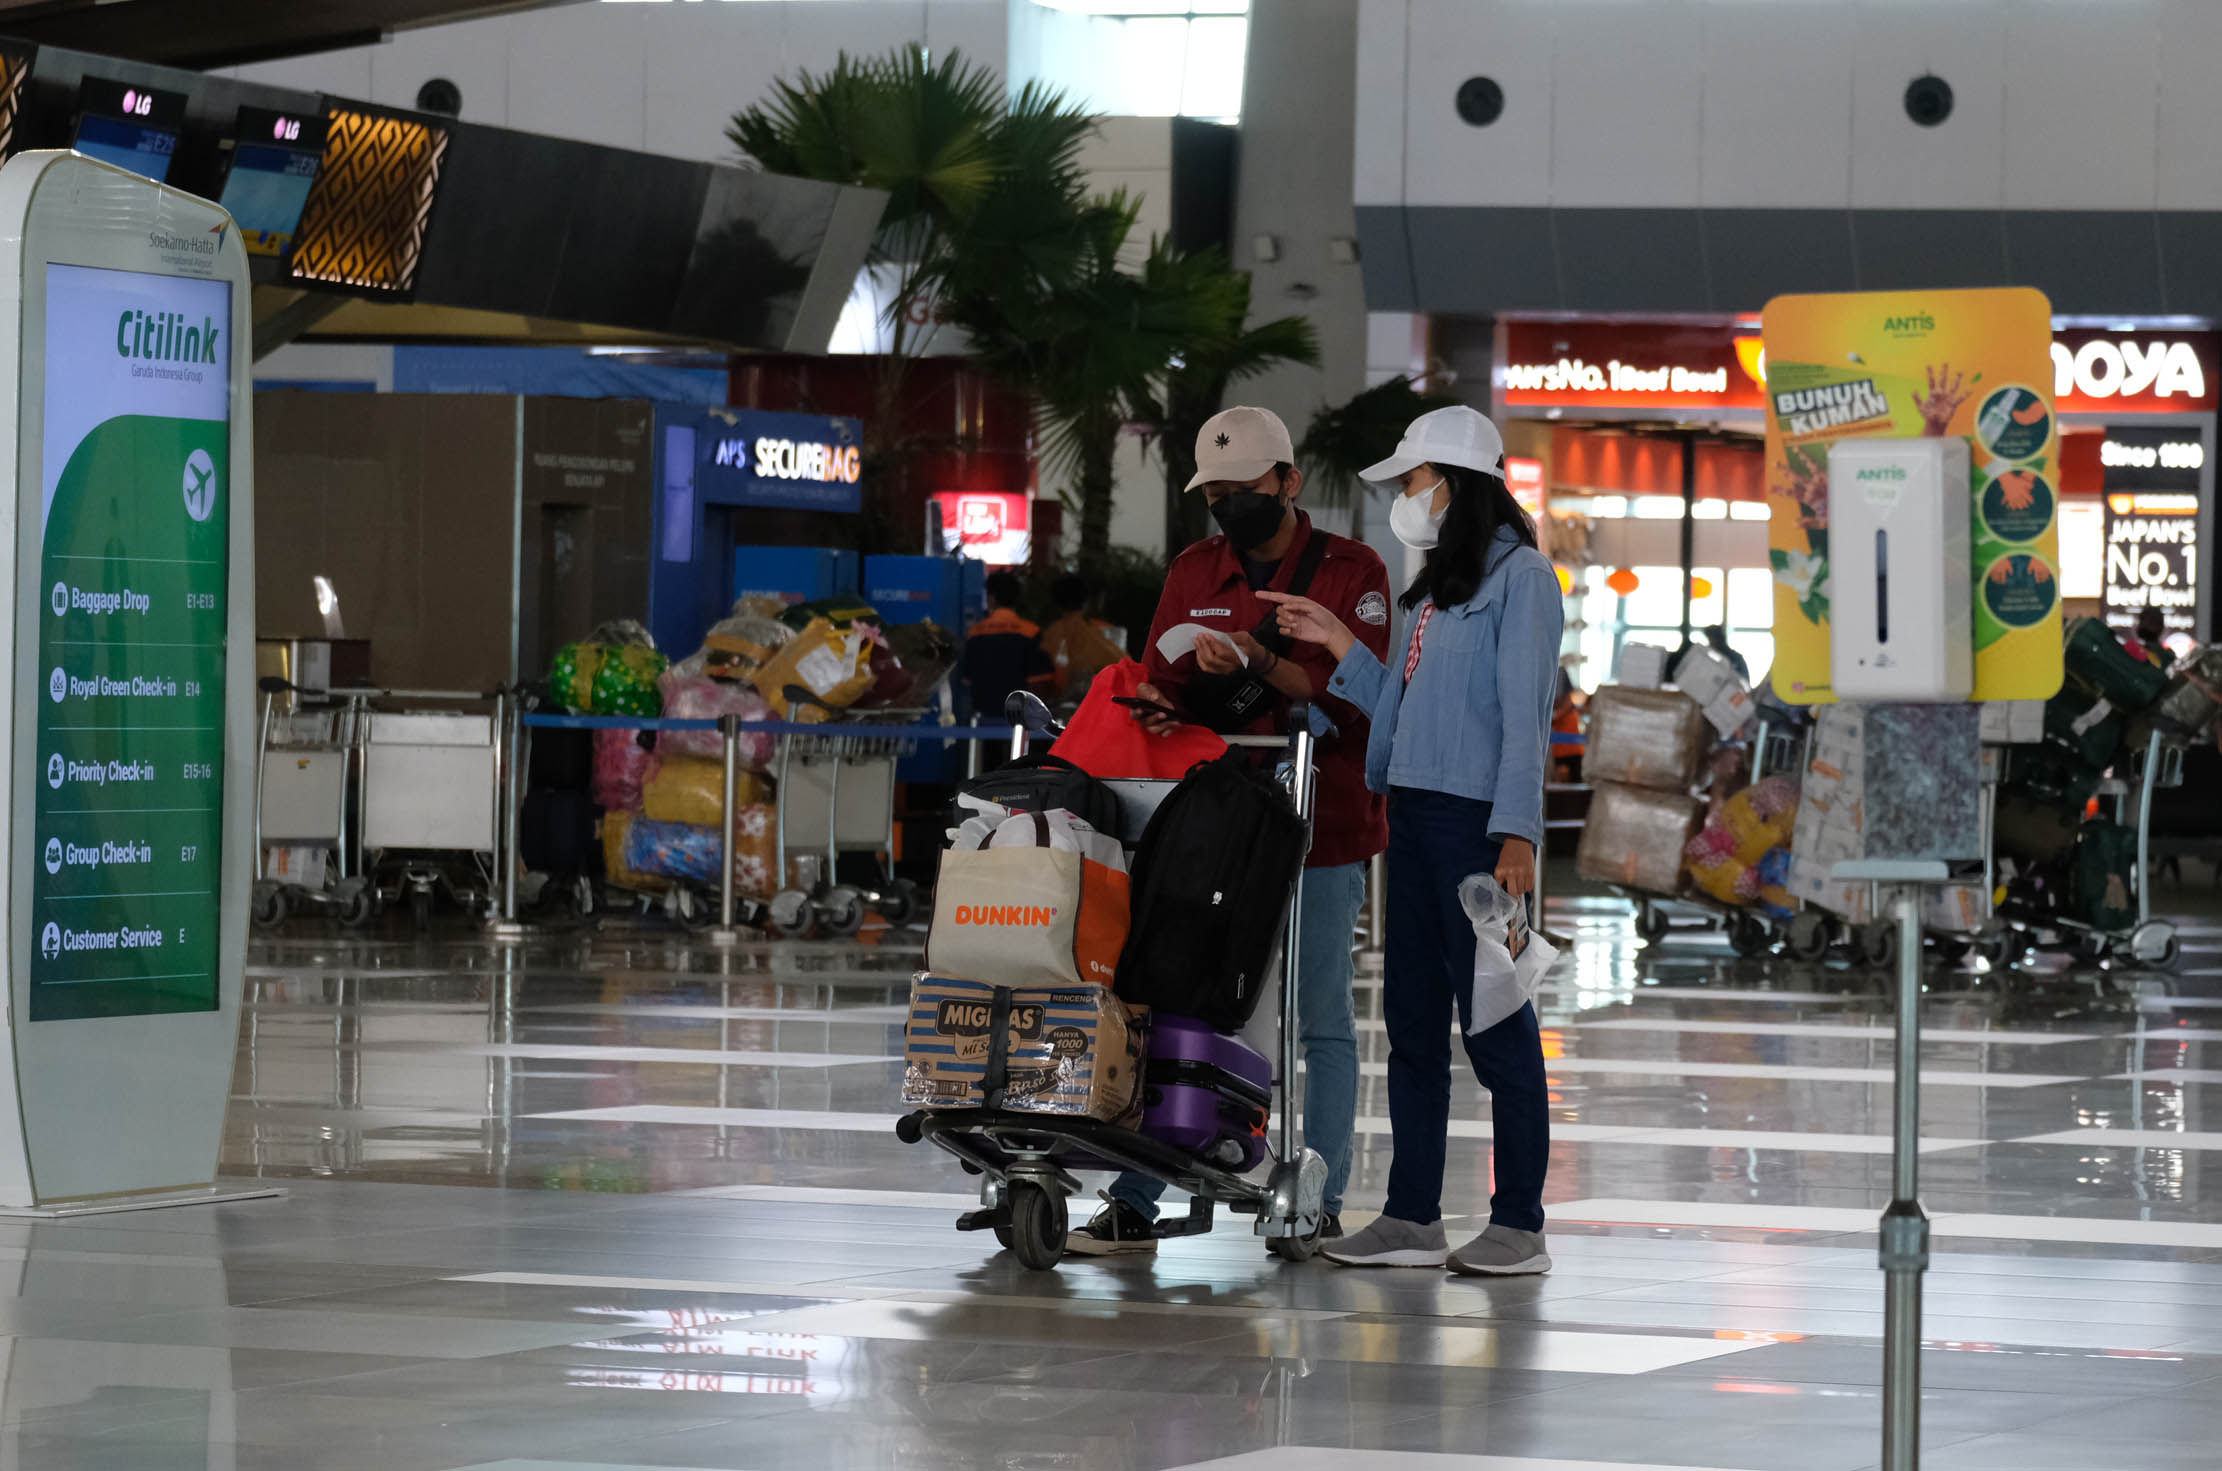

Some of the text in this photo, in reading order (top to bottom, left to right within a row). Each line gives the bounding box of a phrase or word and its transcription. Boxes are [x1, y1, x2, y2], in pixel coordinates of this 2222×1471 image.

[134, 93, 152, 116] LG
[284, 120, 301, 140] LG
[117, 310, 219, 365] Citilink
[131, 363, 204, 385] Garuda Indonesia Group
[1777, 381, 1872, 414] BUNUH
[1790, 393, 1887, 436] KUMAN
[715, 438, 746, 469] APS
[72, 587, 214, 615] Baggage Drop E1-E13
[70, 675, 200, 701] Royal Green Check-in E14
[68, 760, 211, 787] Priority Check-in E15-16
[66, 840, 197, 870] Group Check-in E17
[63, 924, 185, 950] Customer Service E
[944, 1004, 1034, 1030] MIGAS
[1056, 1039, 1084, 1049] 1000
